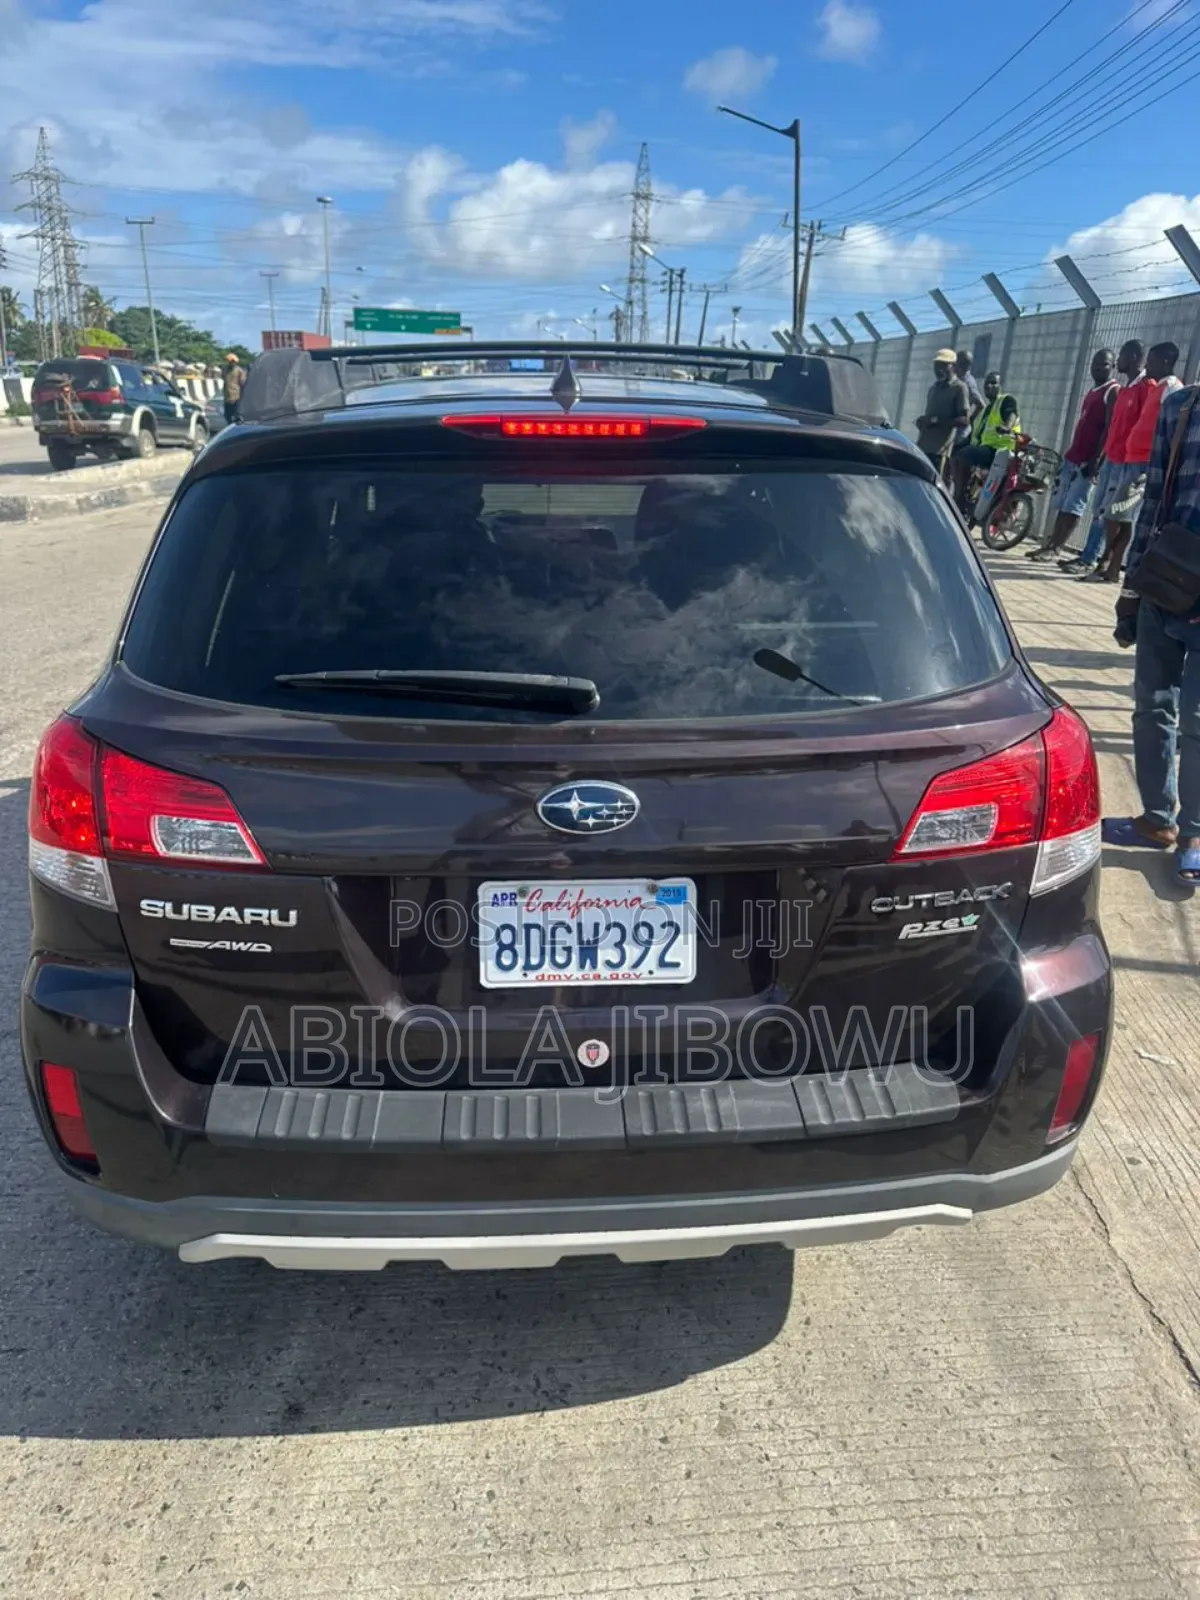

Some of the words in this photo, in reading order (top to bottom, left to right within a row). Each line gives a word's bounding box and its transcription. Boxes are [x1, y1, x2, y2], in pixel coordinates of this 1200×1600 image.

[491, 892, 518, 907] APR
[524, 888, 656, 919] California
[871, 881, 1013, 913] OUTBACK
[140, 899, 298, 927] SUBARU
[208, 940, 272, 952] AWD
[494, 920, 682, 971] 8DGW392
[535, 971, 643, 982] dmv.ca.gov
